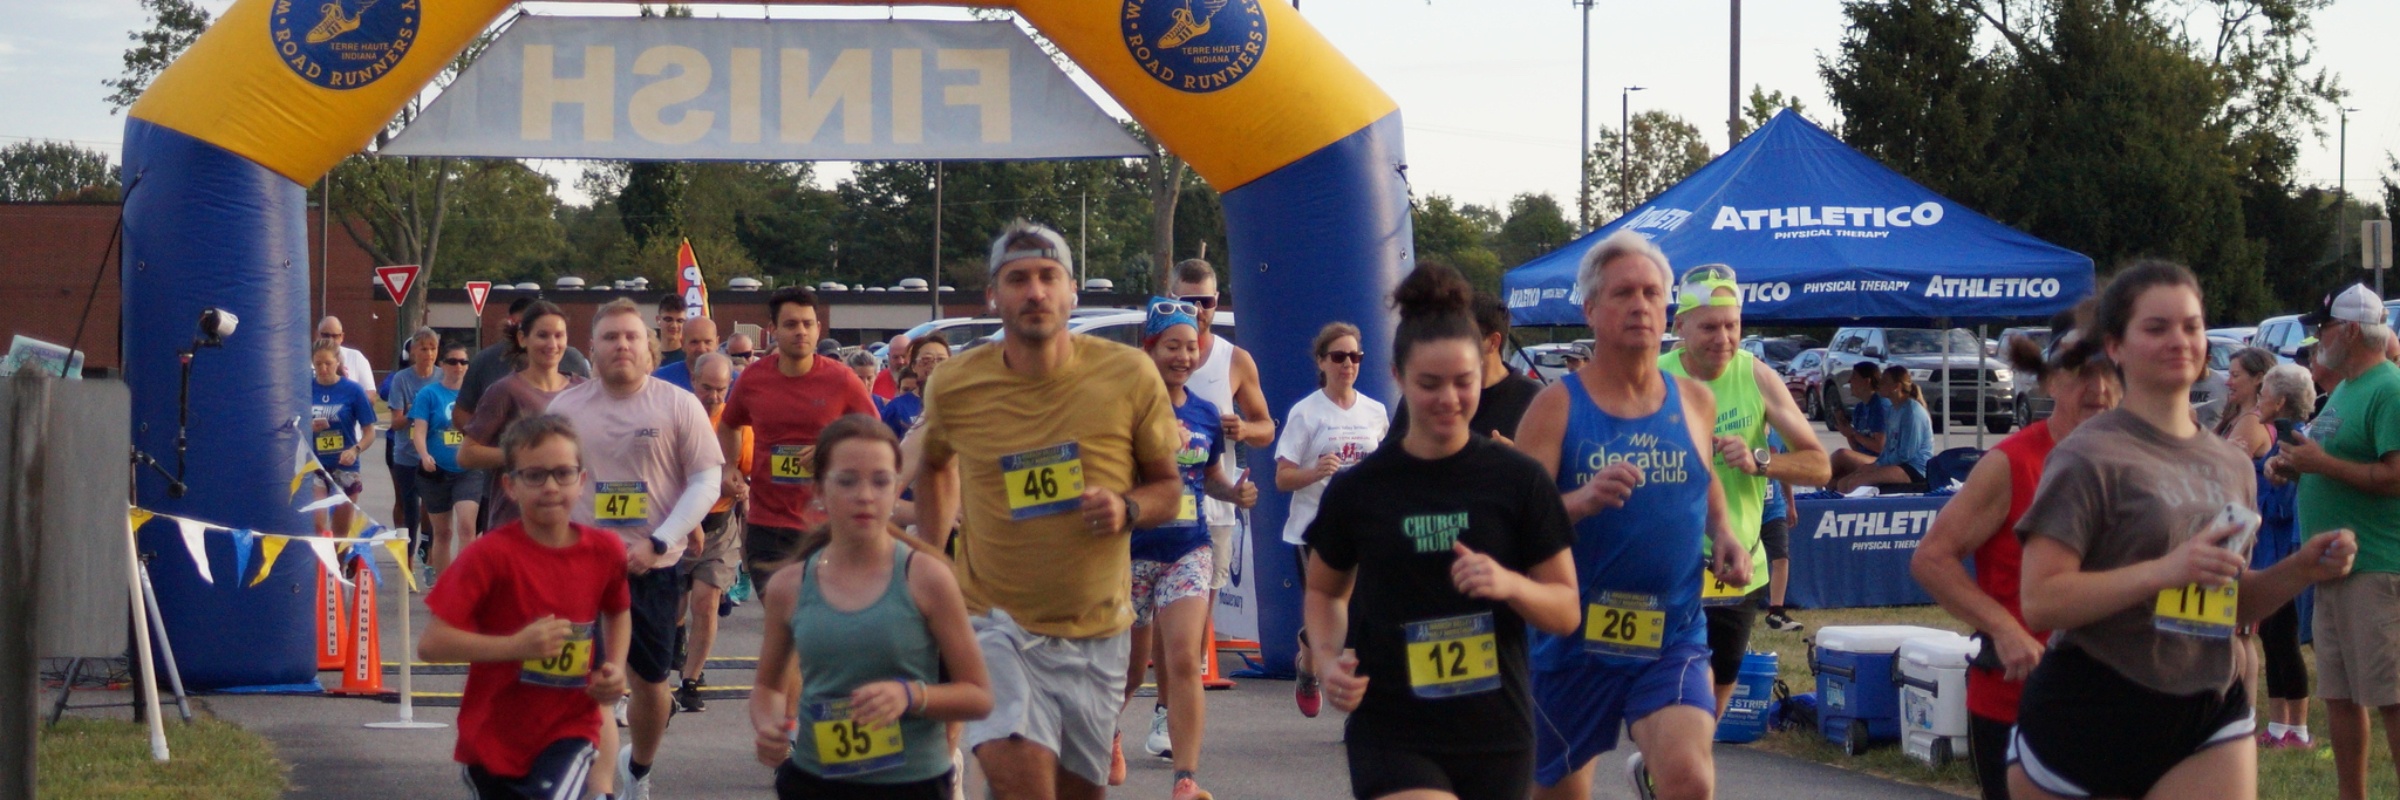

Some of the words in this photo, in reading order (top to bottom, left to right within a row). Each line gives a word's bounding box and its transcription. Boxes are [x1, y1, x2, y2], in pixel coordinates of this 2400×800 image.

[276, 28, 321, 78] ROAD
[330, 28, 413, 86] RUNNERS
[342, 52, 377, 60] INDIANA
[1129, 34, 1174, 81] ROAD
[1184, 31, 1262, 89] RUNNERS
[1182, 46, 1210, 55] TERRE
[1212, 45, 1241, 54] HAUTE
[1193, 55, 1229, 64] INDIANA
[1711, 202, 1944, 231] ATHLETICO
[1774, 229, 1833, 239] PHYSICAL
[1836, 230, 1890, 239] THERAPY
[1803, 281, 1857, 294] PHYSICAL
[1861, 280, 1910, 293] THERAPY
[1925, 275, 2060, 298] ATHLETICO
[322, 437, 335, 448] 34
[450, 431, 463, 443] 75
[781, 457, 801, 475] 45
[1588, 446, 1687, 470] decatur
[1023, 467, 1059, 501] 46
[1651, 466, 1688, 483] club
[606, 494, 630, 516] 47
[1404, 512, 1470, 537] CHURCH
[1813, 510, 1938, 540] ATHLETI
[1416, 527, 1460, 552] HURT
[1852, 541, 1891, 551] PHYSICAL
[1894, 540, 1920, 549] THERA
[327, 572, 336, 654] MINGMD.NET
[1601, 608, 1637, 641] 26
[1428, 640, 1468, 679] 12
[832, 720, 872, 758] 35
